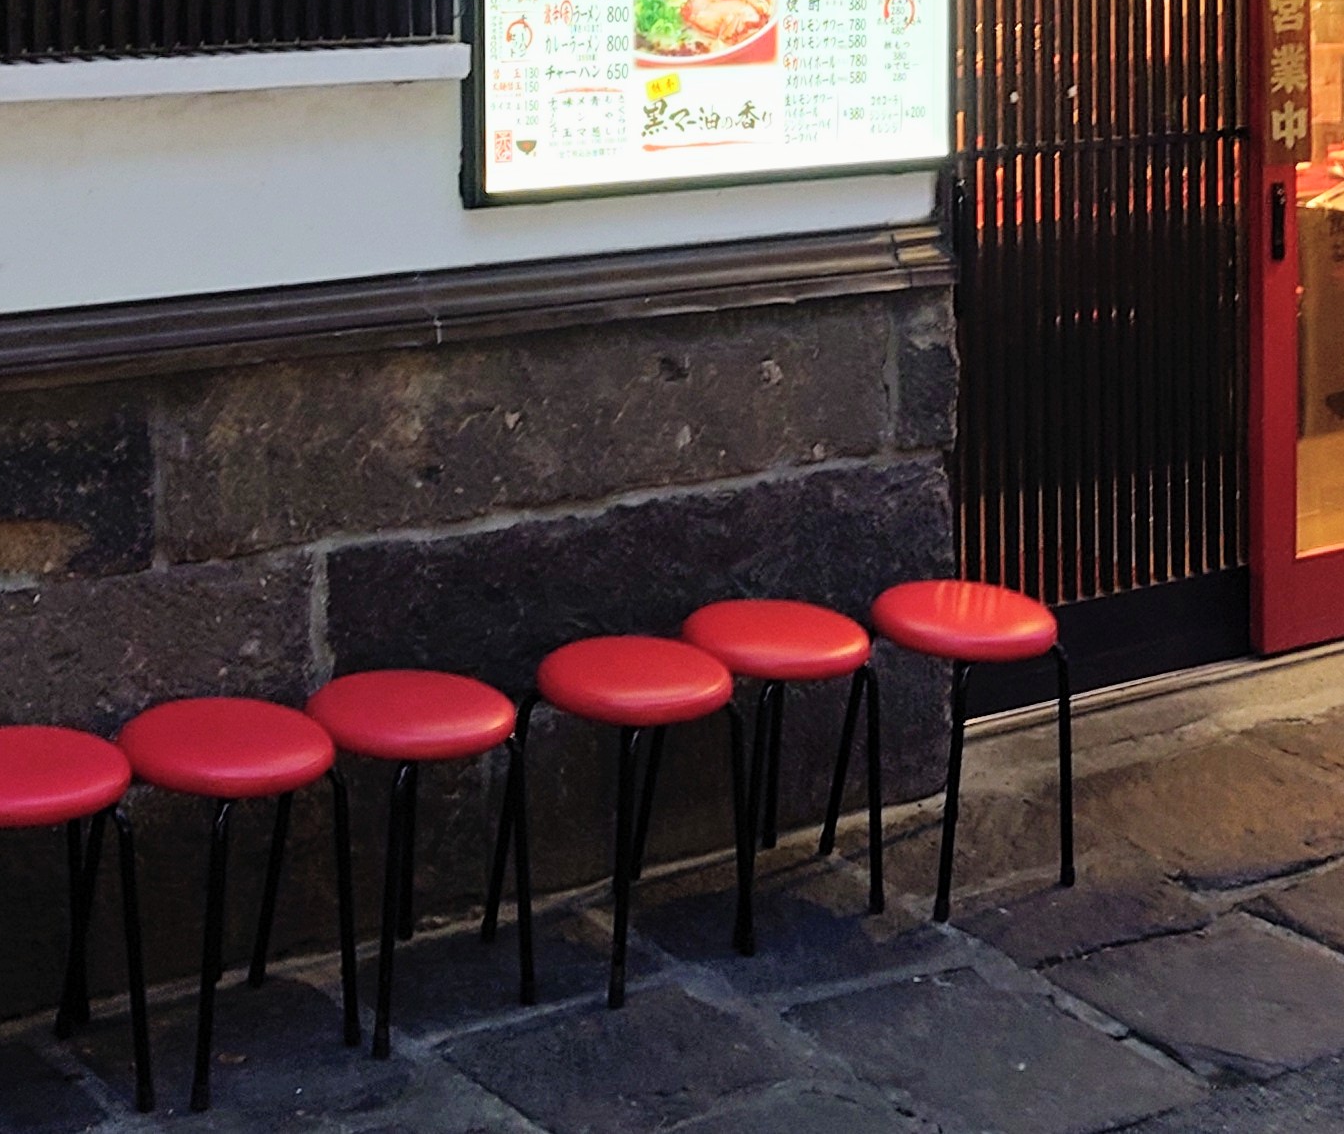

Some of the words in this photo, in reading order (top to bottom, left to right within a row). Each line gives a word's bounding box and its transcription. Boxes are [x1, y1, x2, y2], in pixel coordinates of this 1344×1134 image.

[606, 5, 629, 23] 800
[849, 18, 867, 31] 780
[606, 34, 629, 52] 800
[847, 34, 867, 49] 580
[849, 54, 868, 67] 780
[545, 64, 601, 81] チャーハン
[606, 62, 629, 80] 650
[849, 71, 868, 84] 580
[641, 97, 774, 138] 黒マー油の香り
